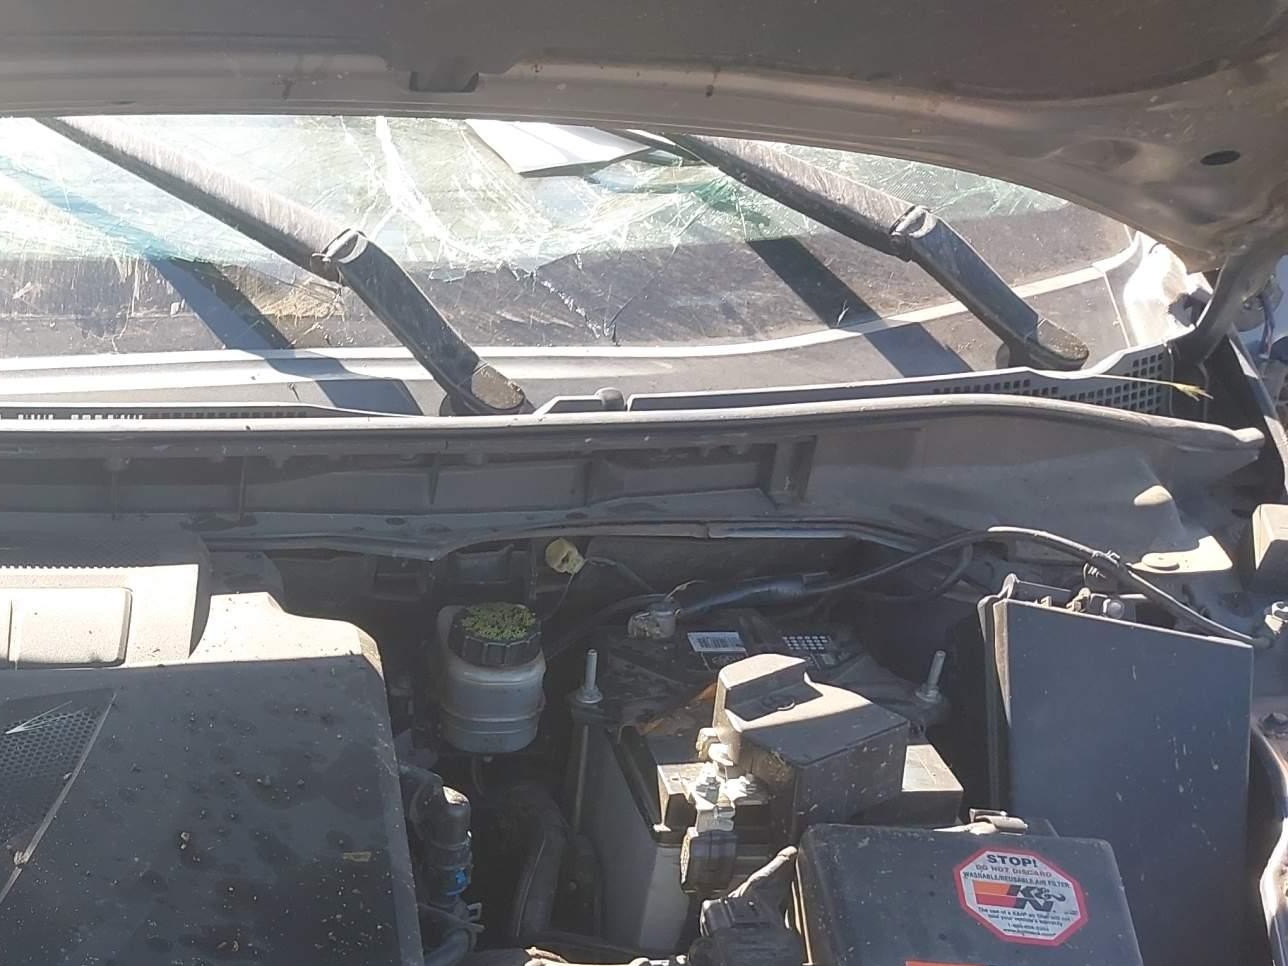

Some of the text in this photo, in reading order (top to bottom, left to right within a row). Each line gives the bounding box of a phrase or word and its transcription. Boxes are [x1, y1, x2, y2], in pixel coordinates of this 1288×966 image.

[986, 854, 1039, 868] STOP!
[975, 864, 1053, 878] DO NOT DISCARD
[1047, 880, 1072, 888] FILTER
[1007, 884, 1066, 913] K&N
